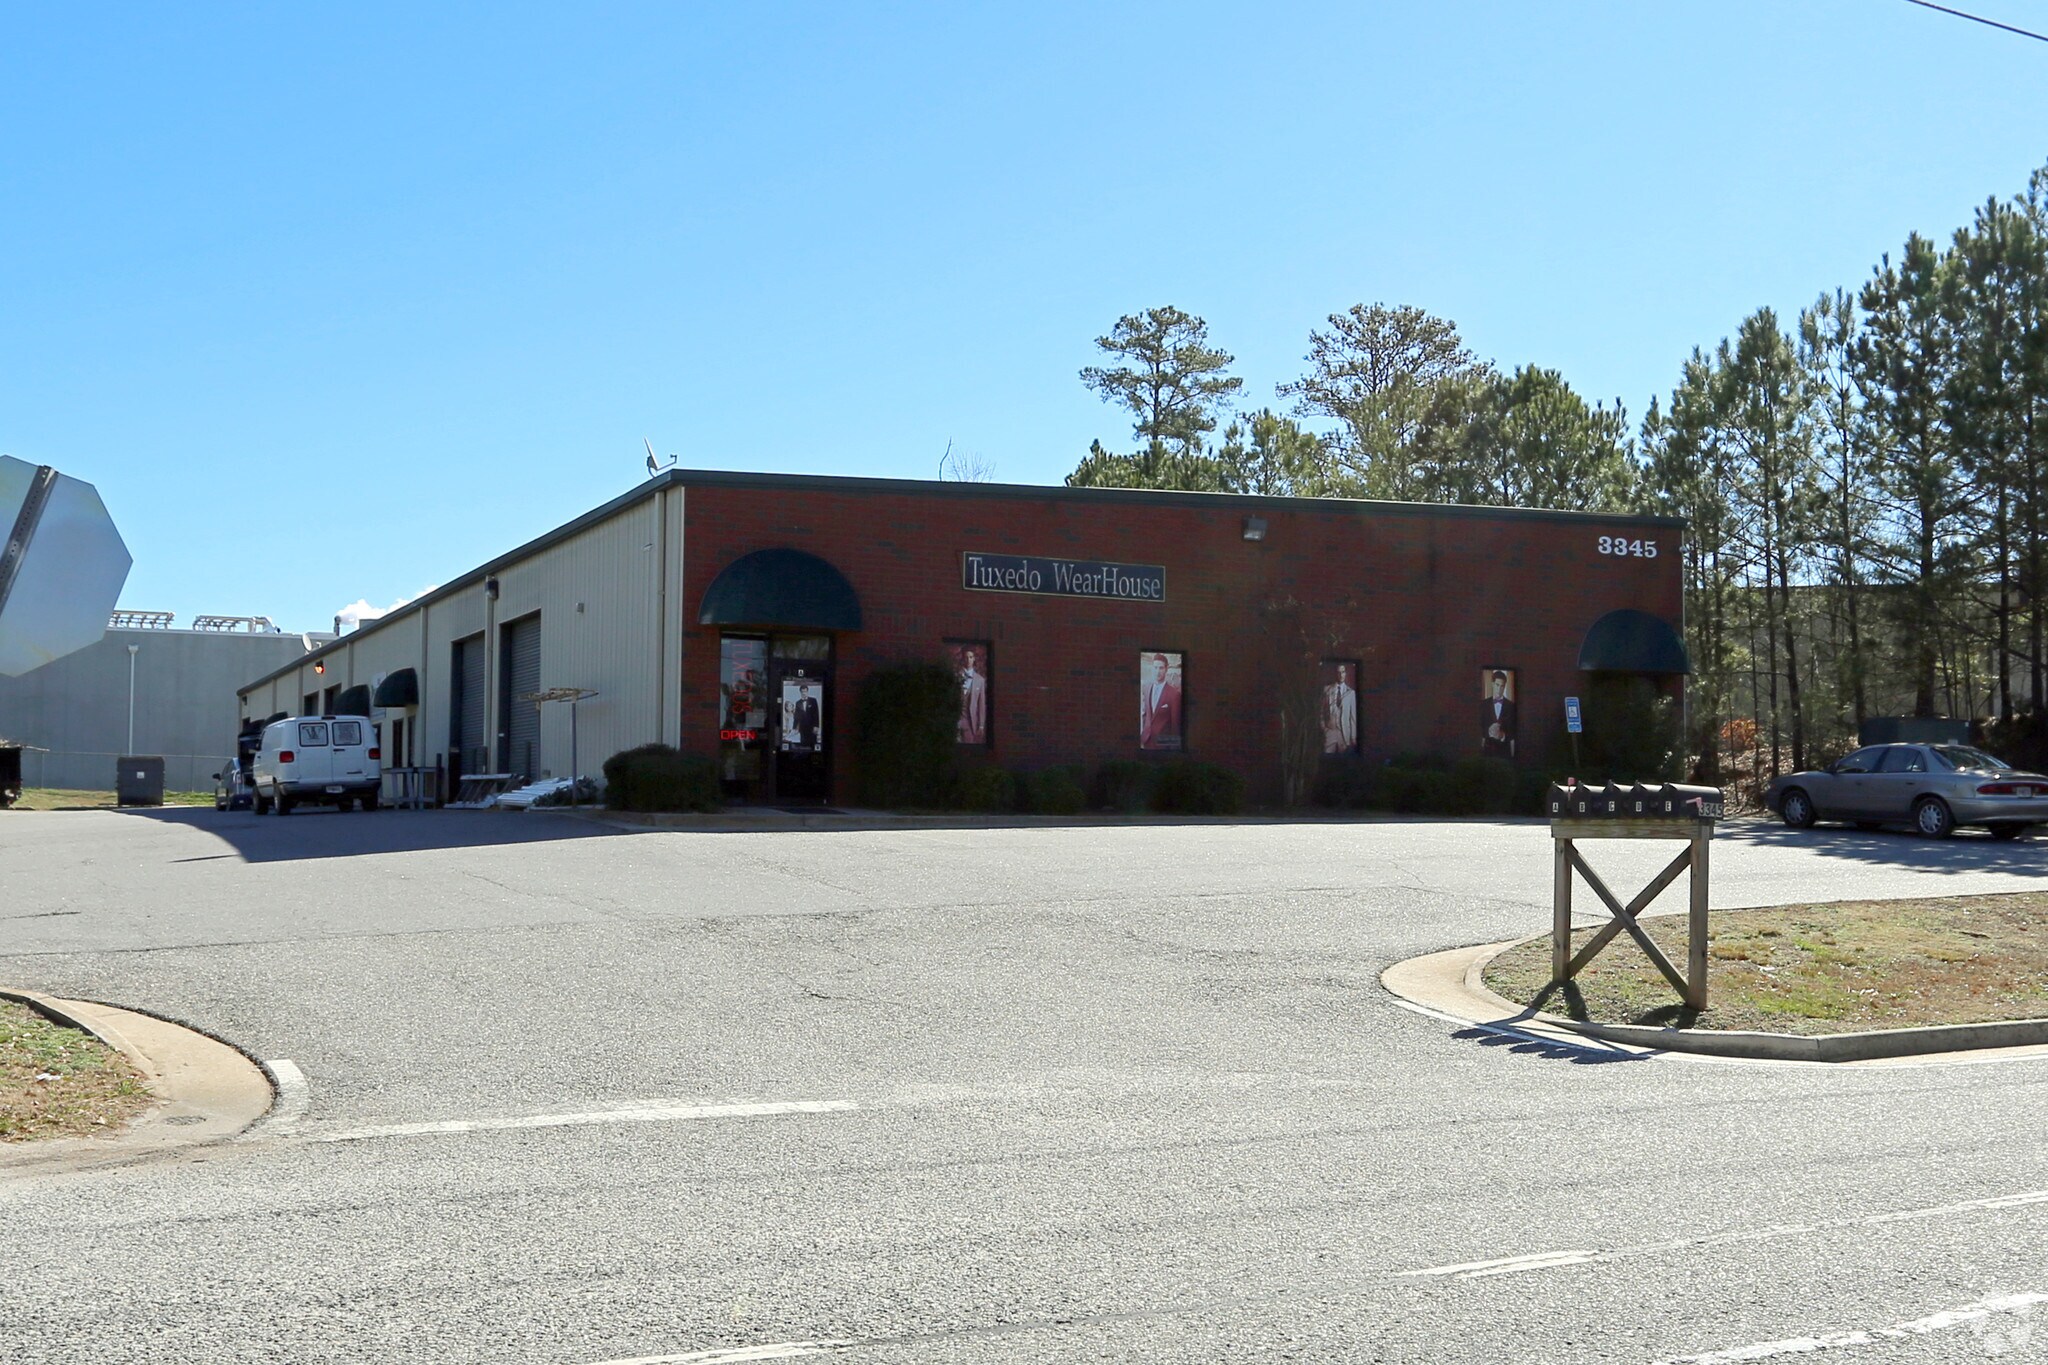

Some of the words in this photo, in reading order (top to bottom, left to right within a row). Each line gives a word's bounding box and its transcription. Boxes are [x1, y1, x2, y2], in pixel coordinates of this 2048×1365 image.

[1597, 535, 1657, 558] 3345
[968, 556, 1041, 591] Tuxedo
[1053, 562, 1161, 599] WearHouse
[720, 729, 757, 740] OPEN
[1699, 803, 1723, 817] 3345
